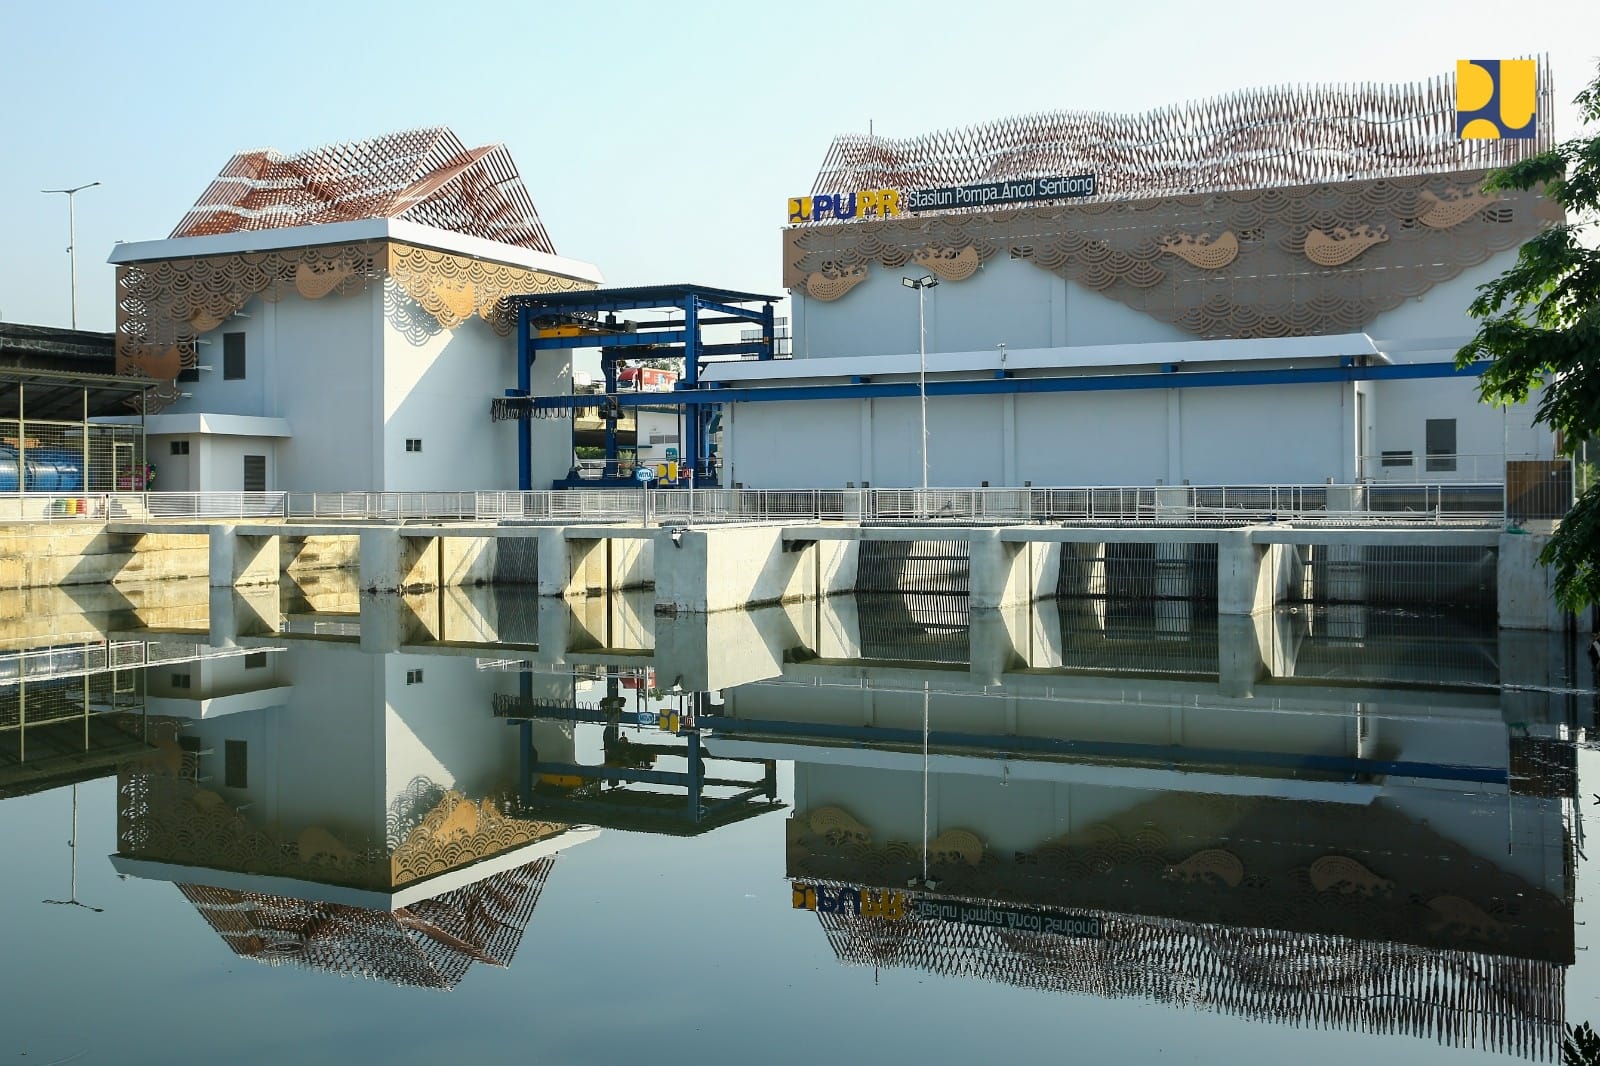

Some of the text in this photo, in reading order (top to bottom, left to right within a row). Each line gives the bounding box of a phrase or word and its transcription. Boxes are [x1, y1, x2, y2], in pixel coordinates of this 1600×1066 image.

[813, 189, 899, 221] PUPR
[909, 177, 1094, 208] Stasiun Pompa Ancol Sentiong
